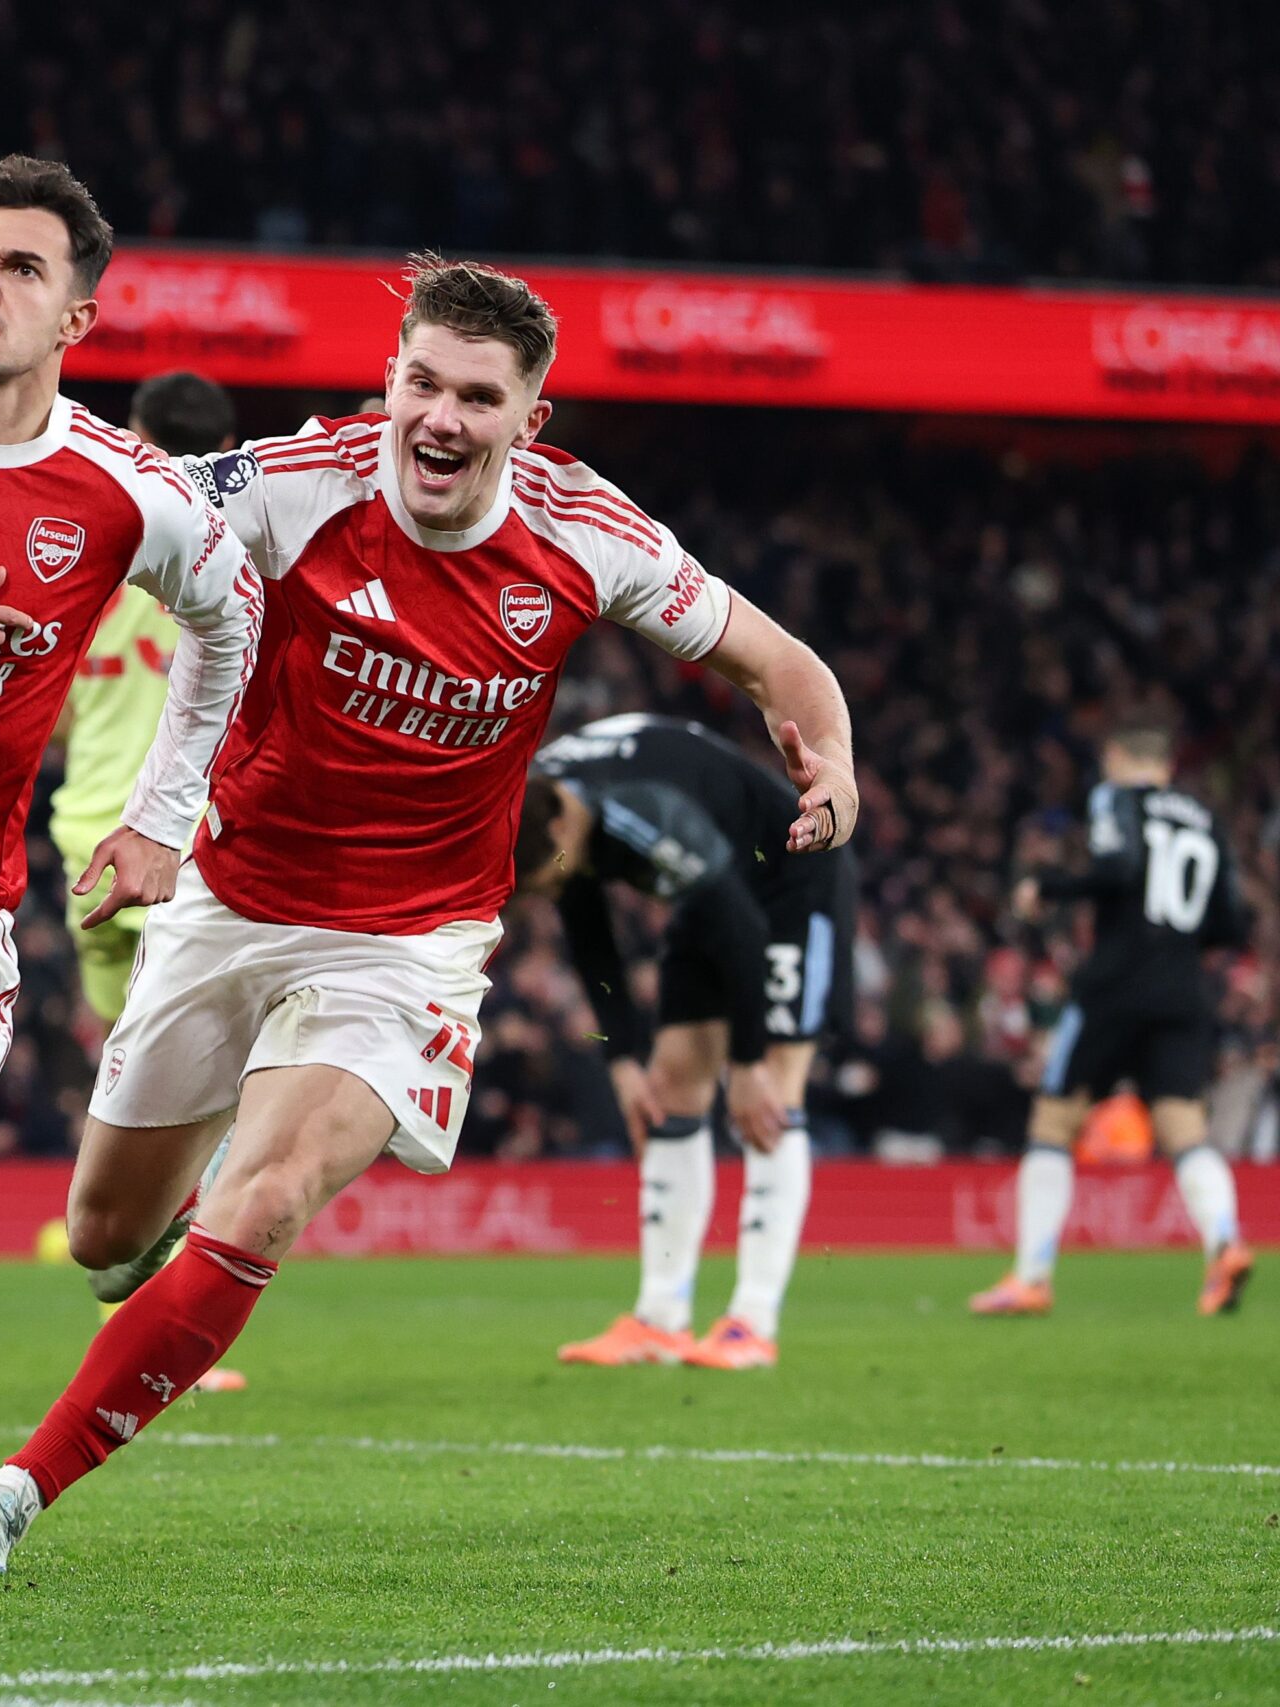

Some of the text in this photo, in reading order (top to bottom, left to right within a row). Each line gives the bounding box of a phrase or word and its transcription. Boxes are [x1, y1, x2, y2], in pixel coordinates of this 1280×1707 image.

[37, 526, 78, 544] Arsenal
[508, 595, 544, 605] Arsenal
[322, 632, 546, 712] Emirates
[341, 690, 510, 746] FLY BETTER
[1143, 818, 1218, 933] 10
[764, 943, 801, 1002] 3
